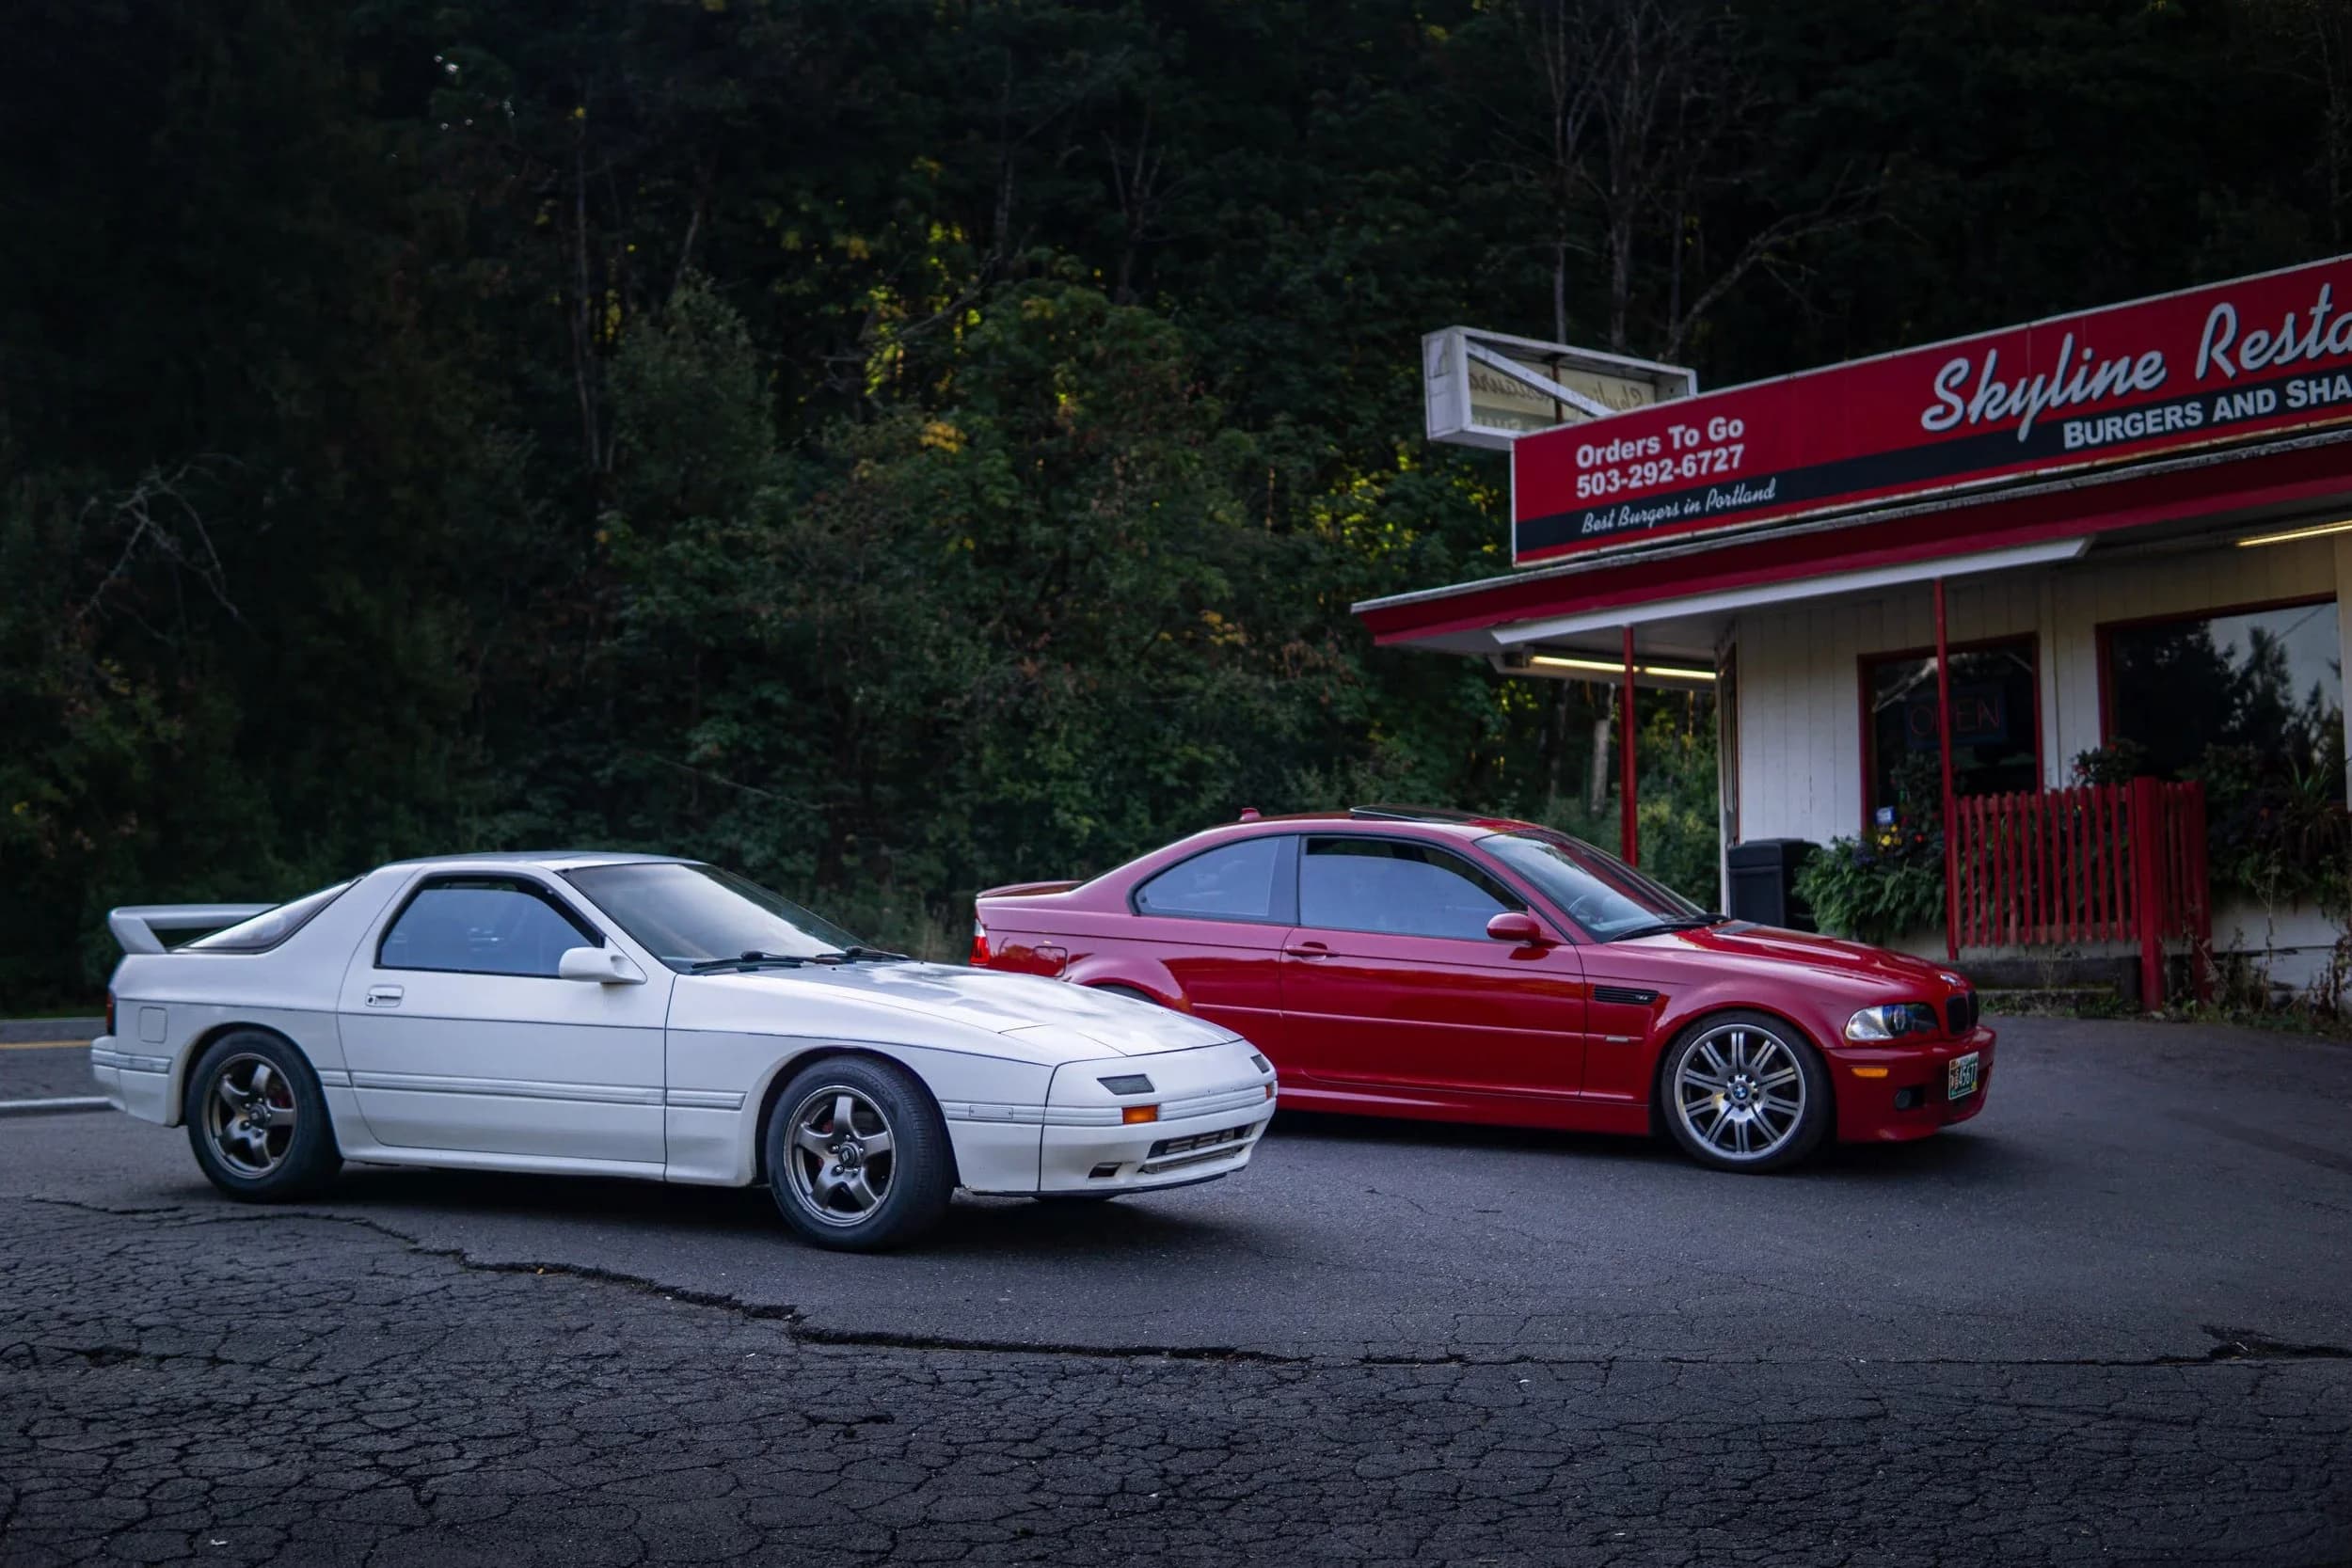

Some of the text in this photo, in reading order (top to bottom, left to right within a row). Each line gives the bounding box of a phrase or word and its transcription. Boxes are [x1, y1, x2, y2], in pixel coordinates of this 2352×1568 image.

[1920, 283, 2352, 443] Skyline Resta
[2063, 373, 2352, 450] BURGERS AND SHA
[1576, 416, 1744, 468] Orders To Go
[1576, 443, 1745, 499] 503-292-6727
[1581, 477, 1776, 533] Best Burgers in Portland
[1910, 694, 2000, 737] OEN
